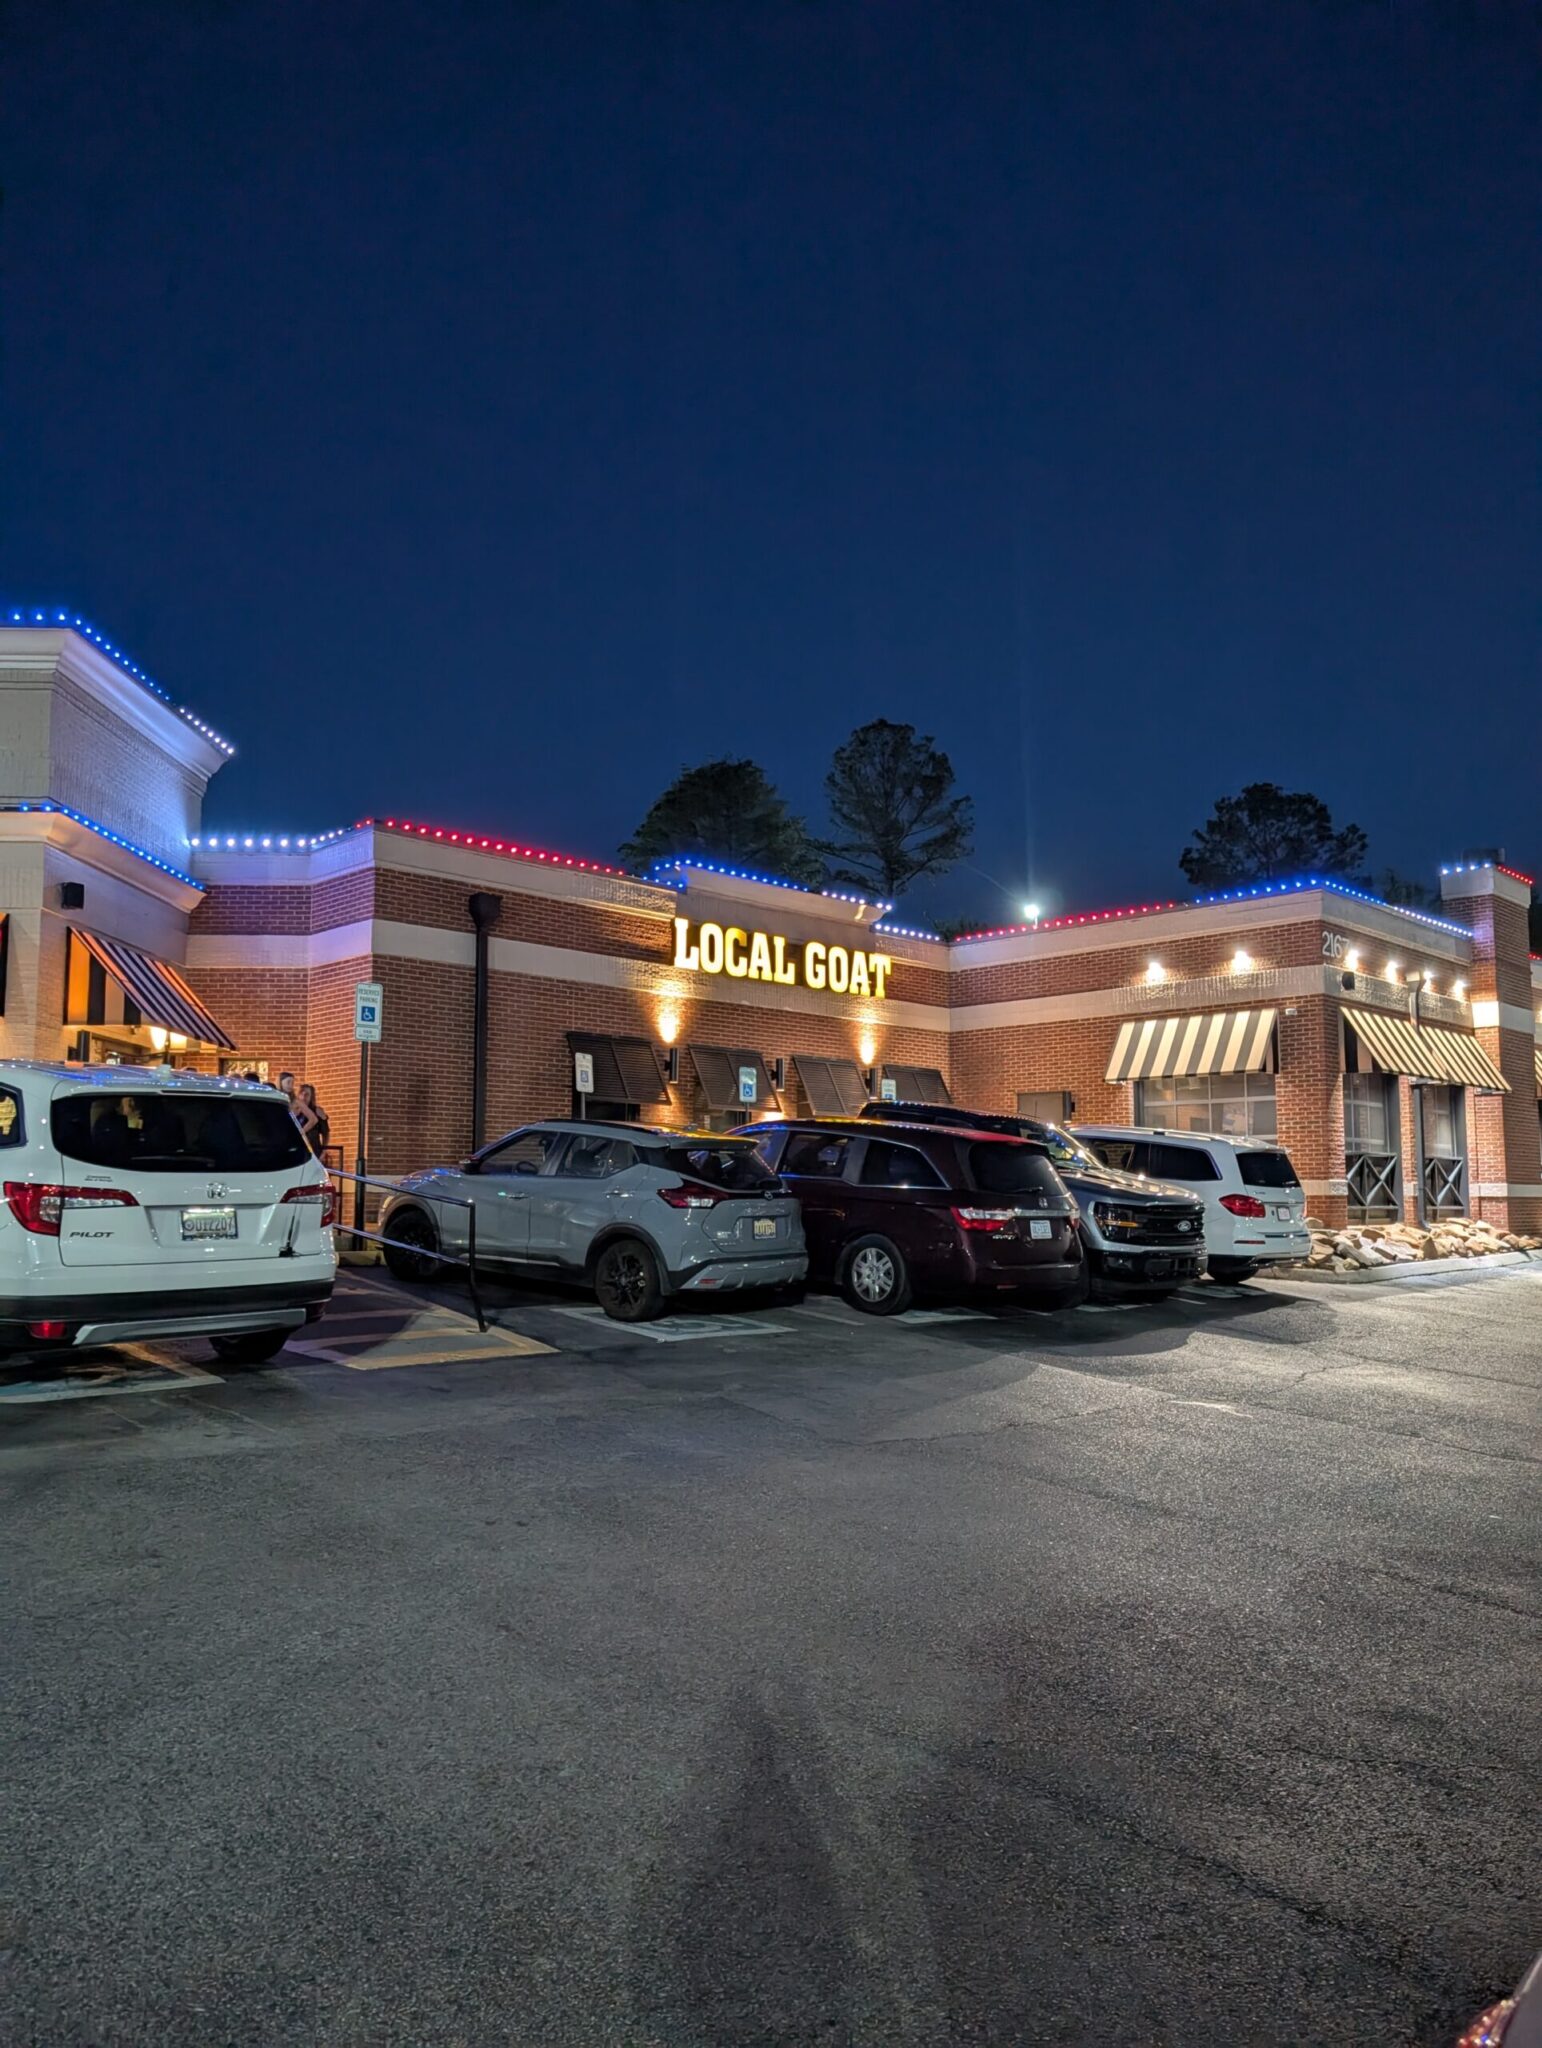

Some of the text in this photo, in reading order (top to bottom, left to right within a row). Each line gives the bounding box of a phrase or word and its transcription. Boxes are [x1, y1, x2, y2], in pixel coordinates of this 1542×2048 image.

[673, 917, 892, 999] LOCAL GOAT
[1322, 930, 1350, 958] 2167
